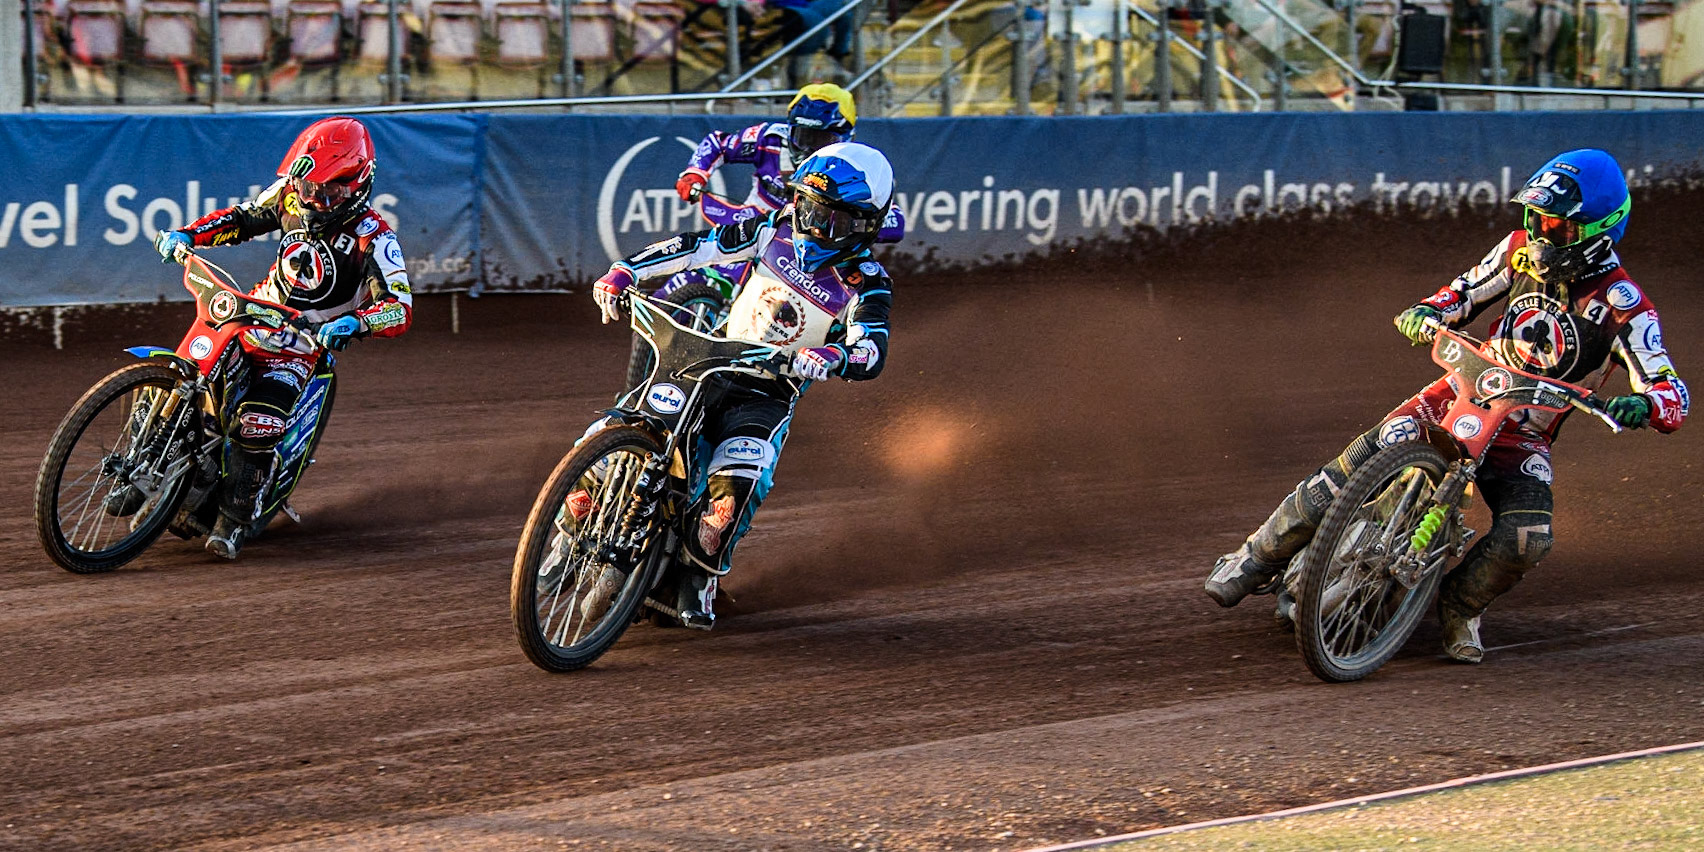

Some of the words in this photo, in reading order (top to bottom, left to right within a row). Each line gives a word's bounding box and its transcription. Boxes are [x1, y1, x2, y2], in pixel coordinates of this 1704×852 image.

[1077, 171, 1217, 229] world
[620, 188, 702, 232] ATPI
[338, 236, 353, 250] 3
[282, 233, 305, 248] BELLE
[320, 252, 332, 276] ACES
[776, 255, 831, 303] Crendon
[1617, 284, 1634, 303] ATPI
[1588, 305, 1602, 322] 4
[1512, 297, 1540, 315] BELLE
[1542, 300, 1564, 319] VUE
[1559, 321, 1576, 351] ACES
[652, 392, 682, 408] eurol
[243, 414, 285, 429] CBS
[1457, 420, 1477, 433] ATPI
[728, 447, 761, 455] eurol
